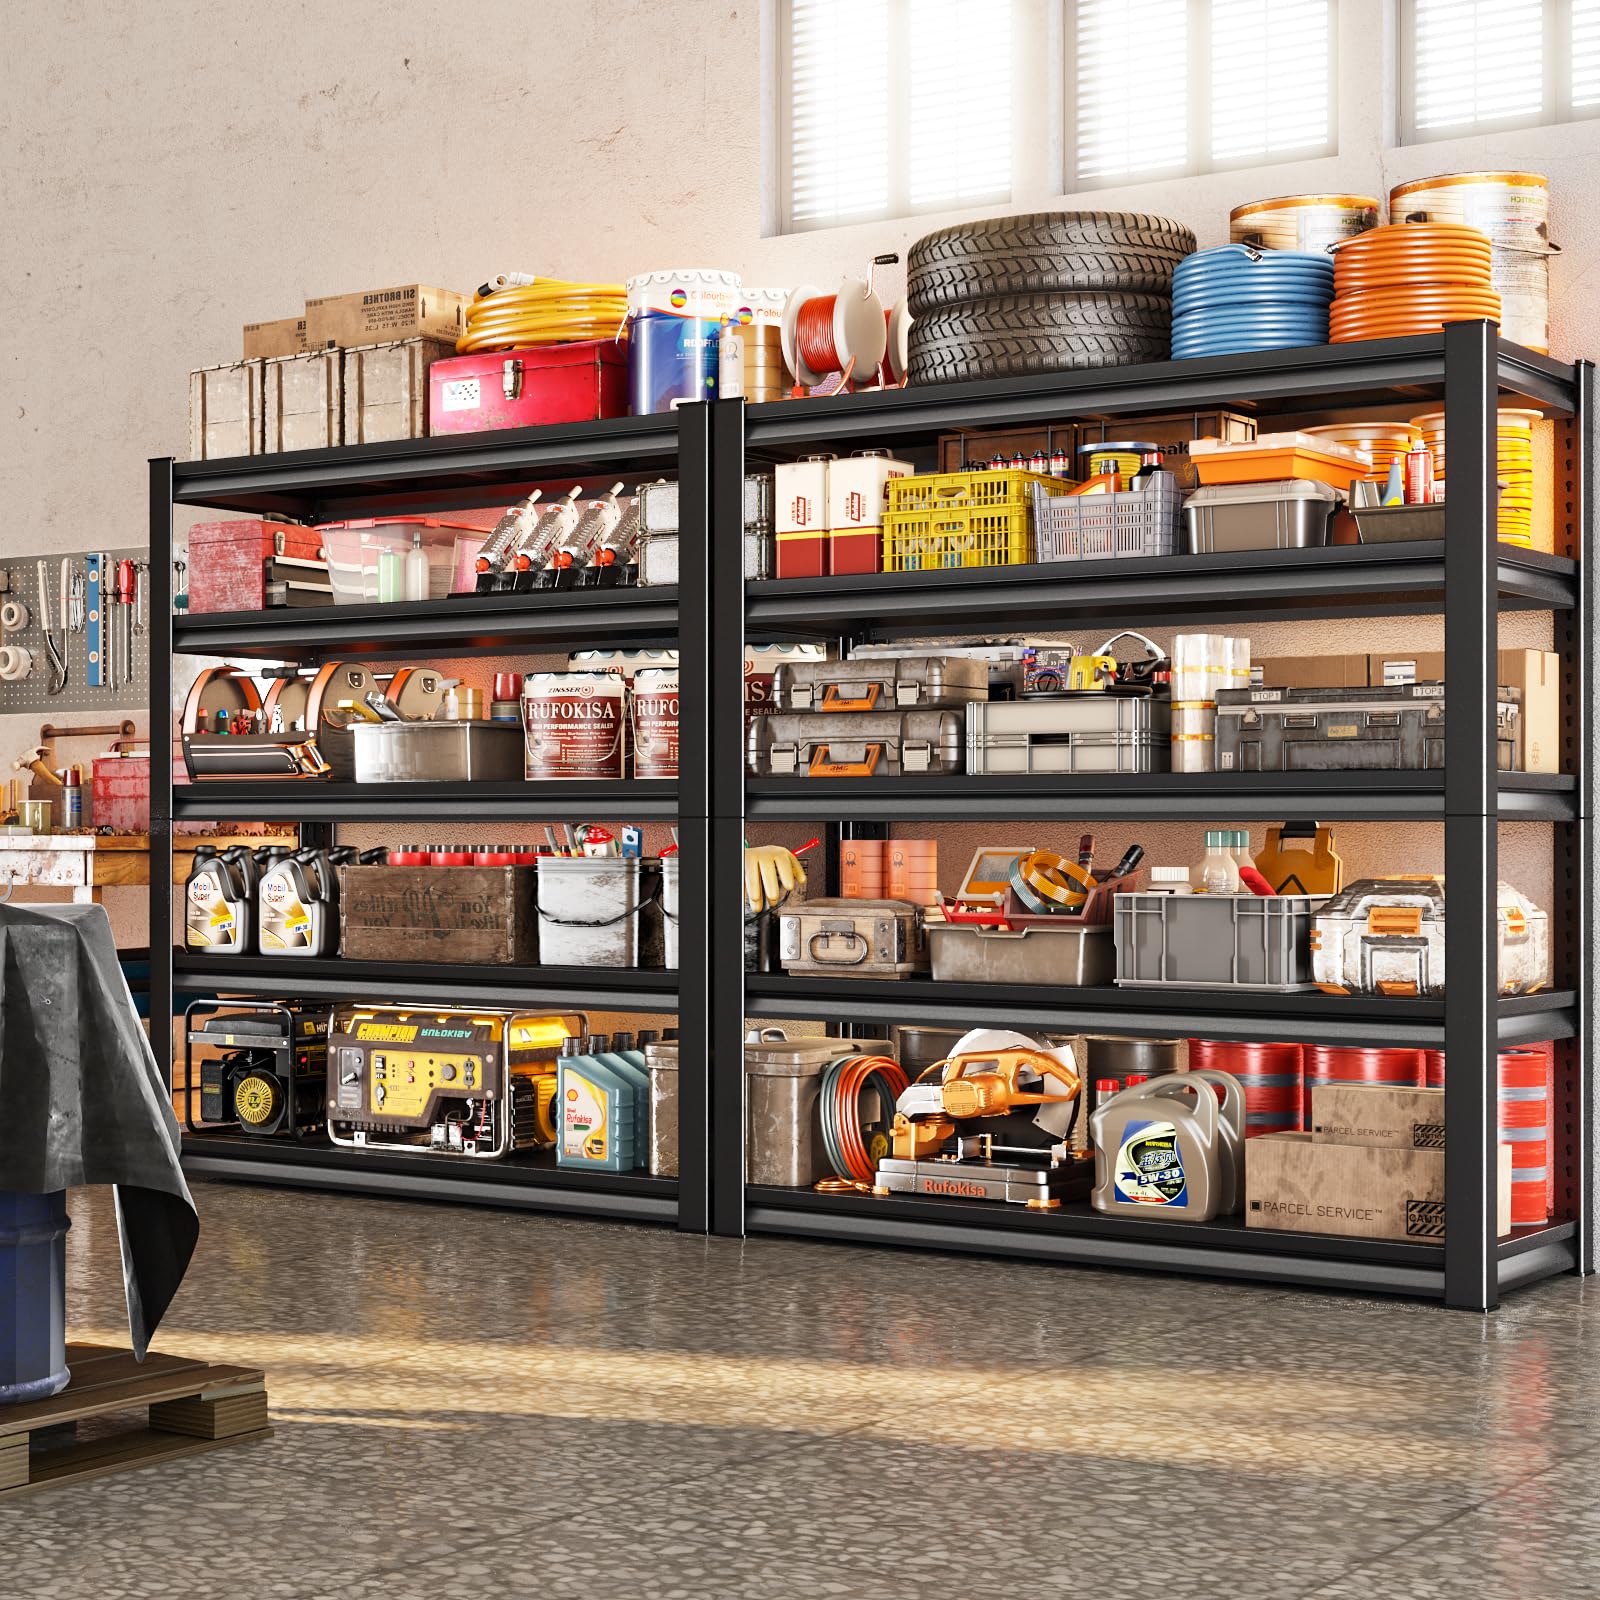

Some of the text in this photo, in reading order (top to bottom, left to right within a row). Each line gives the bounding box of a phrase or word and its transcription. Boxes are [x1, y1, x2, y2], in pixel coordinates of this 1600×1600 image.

[1258, 692, 1273, 700] TOP
[528, 702, 615, 719] RUFOKISA
[194, 882, 211, 891] Mobil
[268, 883, 286, 892] Mobil
[193, 892, 210, 901] Super
[268, 893, 285, 902] Super
[567, 1114, 592, 1124] Rufokisa
[1324, 1127, 1355, 1136] PARCEL
[1140, 1169, 1180, 1184] 5W-30
[924, 1179, 986, 1196] Rufokisa
[1263, 1201, 1312, 1216] PARCEL
